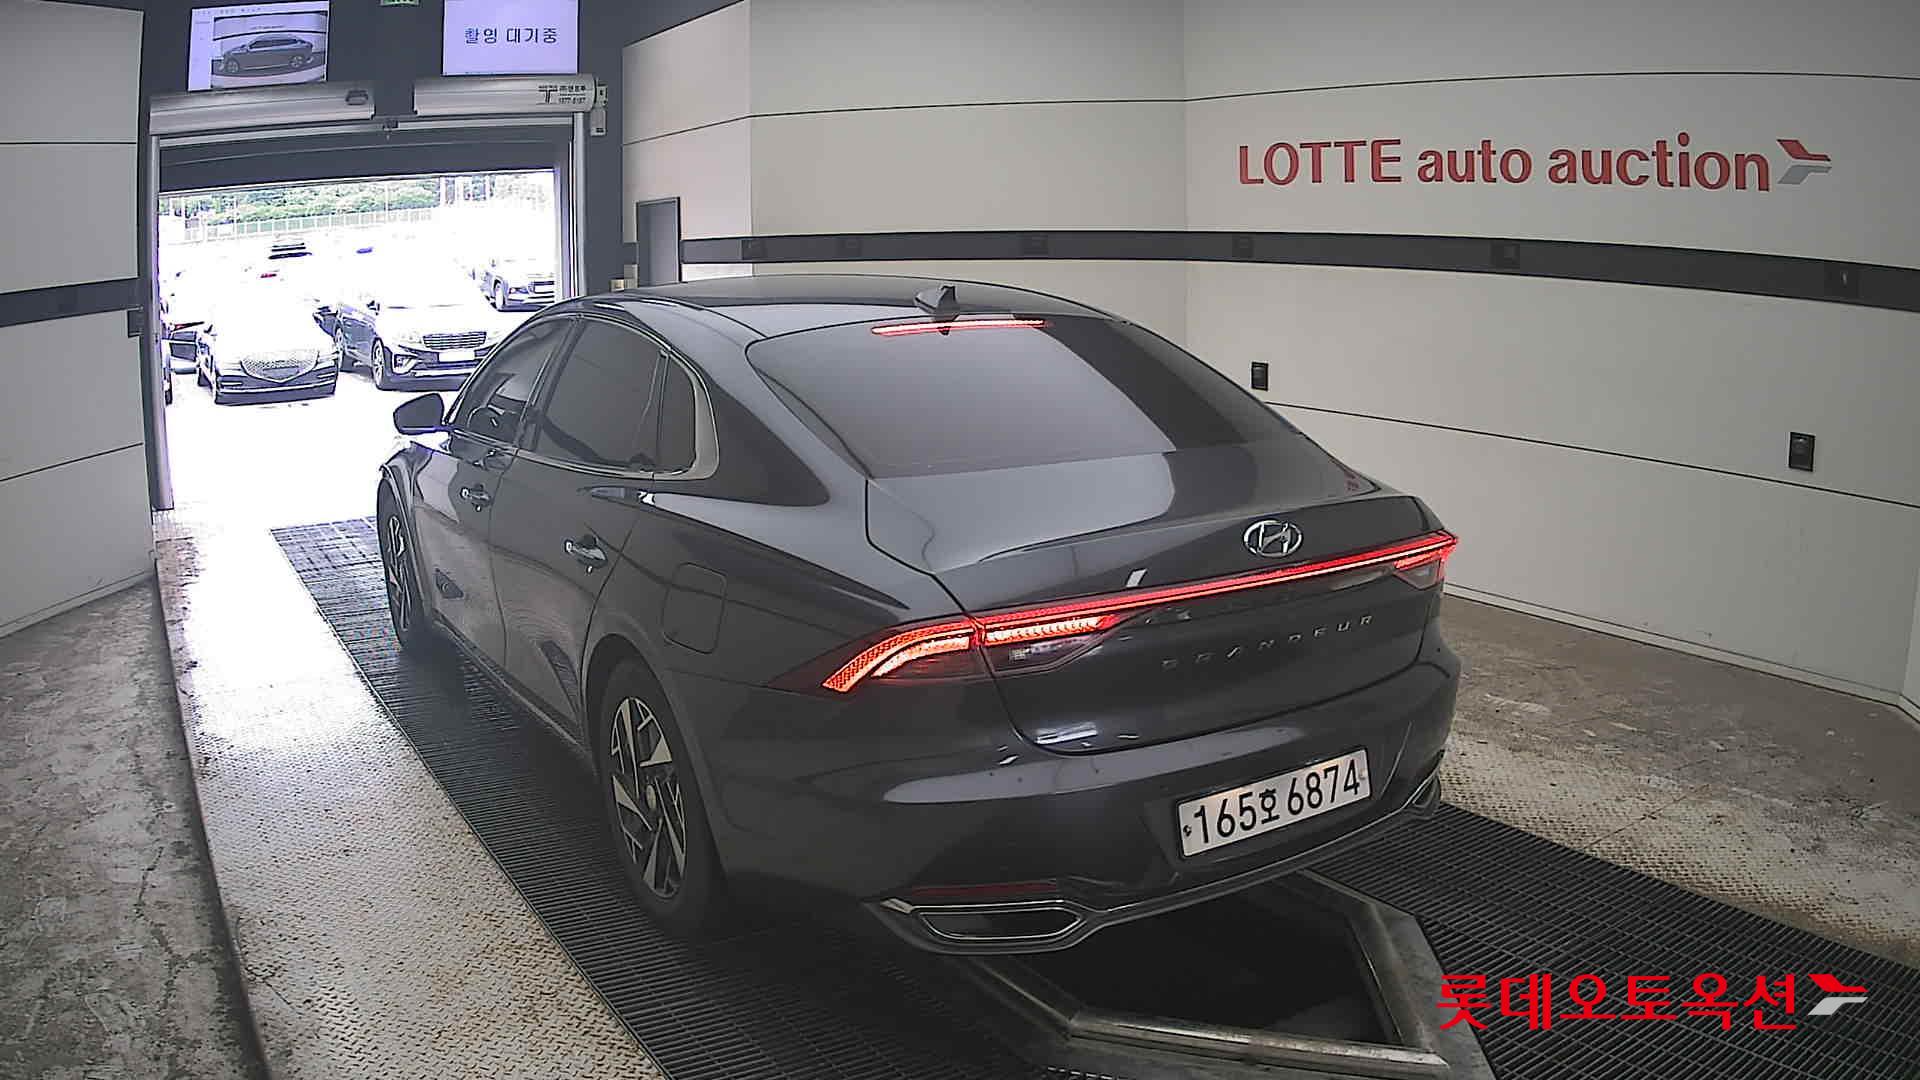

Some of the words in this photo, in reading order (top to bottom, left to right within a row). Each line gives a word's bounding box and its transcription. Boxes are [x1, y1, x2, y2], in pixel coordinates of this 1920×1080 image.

[506, 27, 558, 44] 대기중
[1239, 138, 1401, 185] LOTTE
[1417, 139, 1532, 185] auto
[1547, 131, 1770, 191] auction
